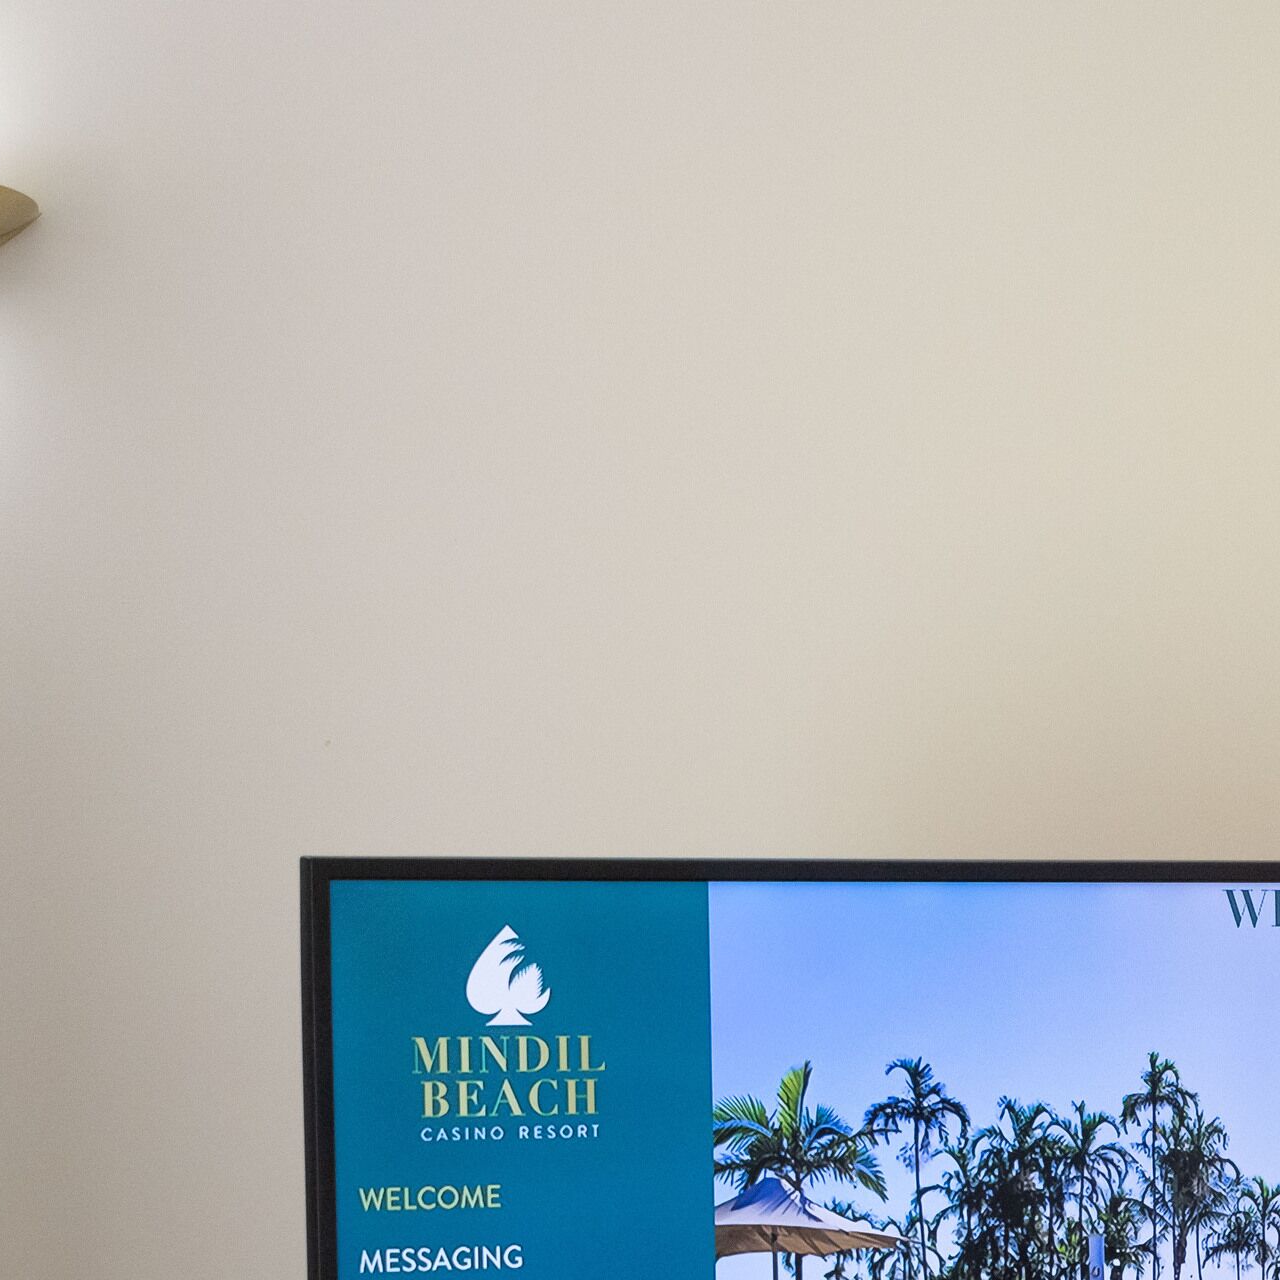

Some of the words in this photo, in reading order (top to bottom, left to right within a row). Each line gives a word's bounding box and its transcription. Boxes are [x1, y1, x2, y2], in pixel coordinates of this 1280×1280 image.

[412, 1035, 606, 1074] MINDIL
[421, 1078, 596, 1118] BEACH
[420, 1125, 505, 1142] CASINO
[518, 1124, 599, 1140] RESORT
[359, 1184, 502, 1212] WELCOME
[359, 1244, 523, 1274] MESSAGING
